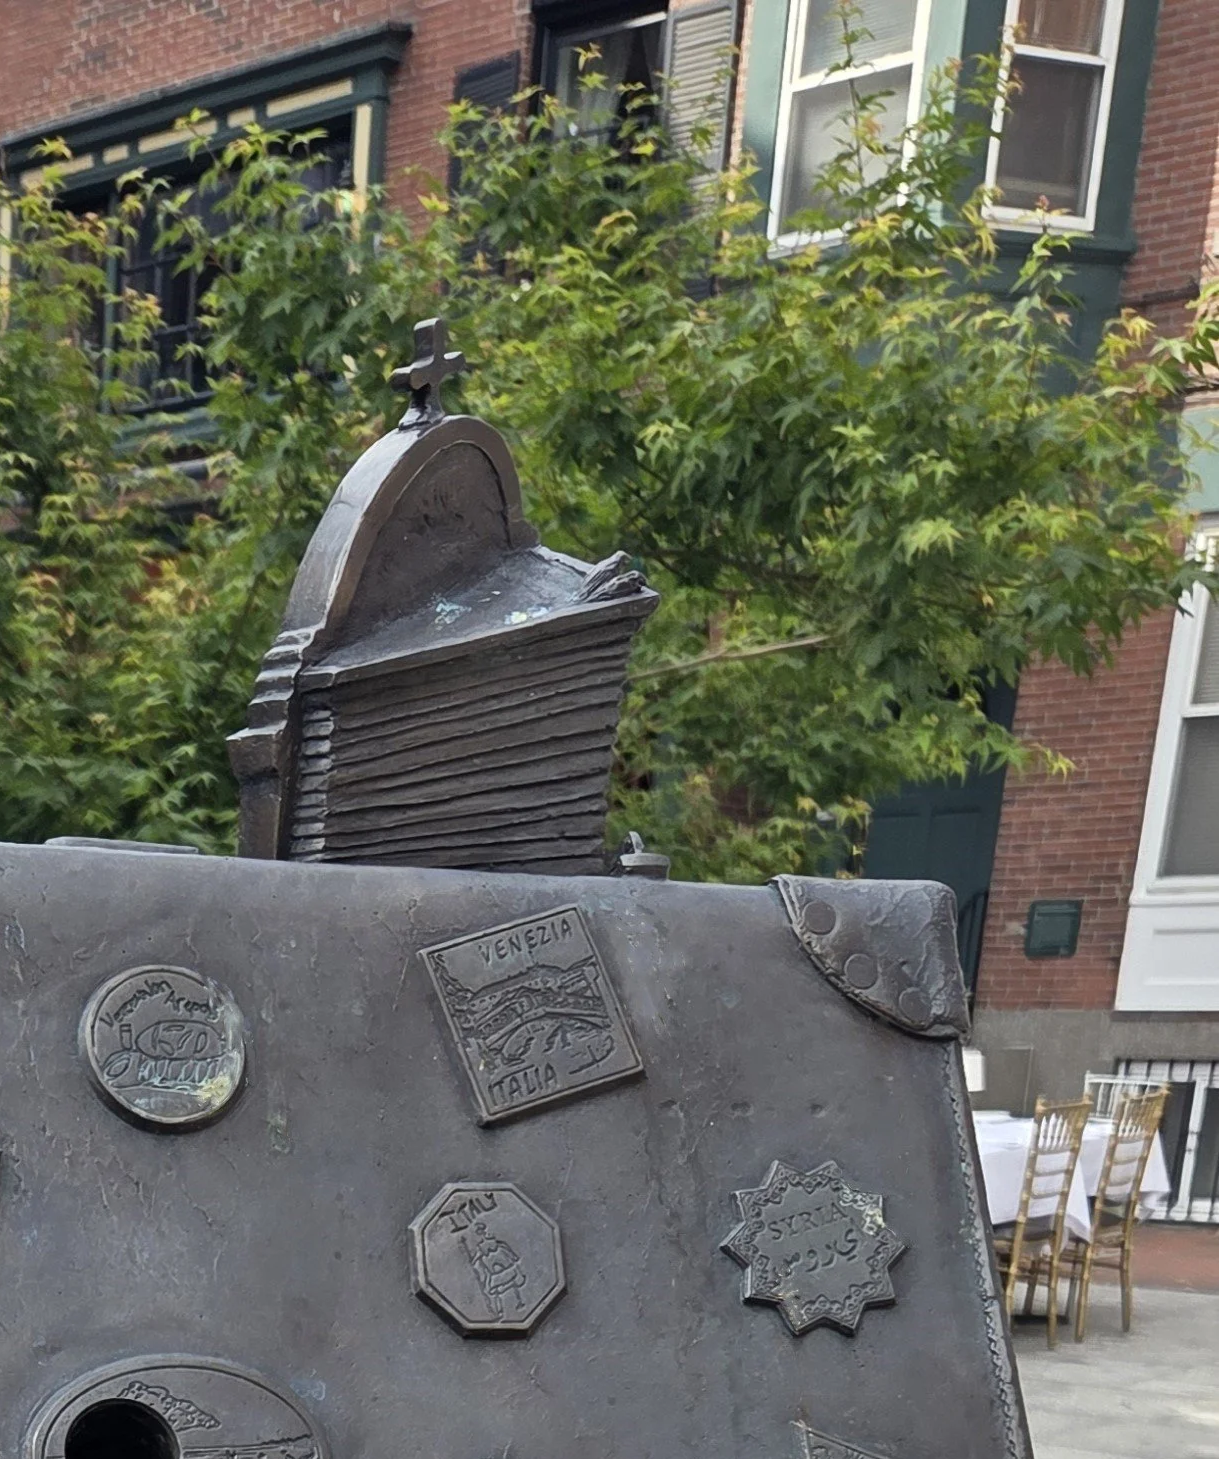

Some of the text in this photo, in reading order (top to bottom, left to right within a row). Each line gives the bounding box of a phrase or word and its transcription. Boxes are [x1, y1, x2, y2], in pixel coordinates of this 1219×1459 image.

[478, 917, 573, 965] VENEZIA
[487, 1062, 559, 1107] ITALIA
[439, 1192, 499, 1234] ITALY
[767, 1202, 849, 1240] SYRIA
